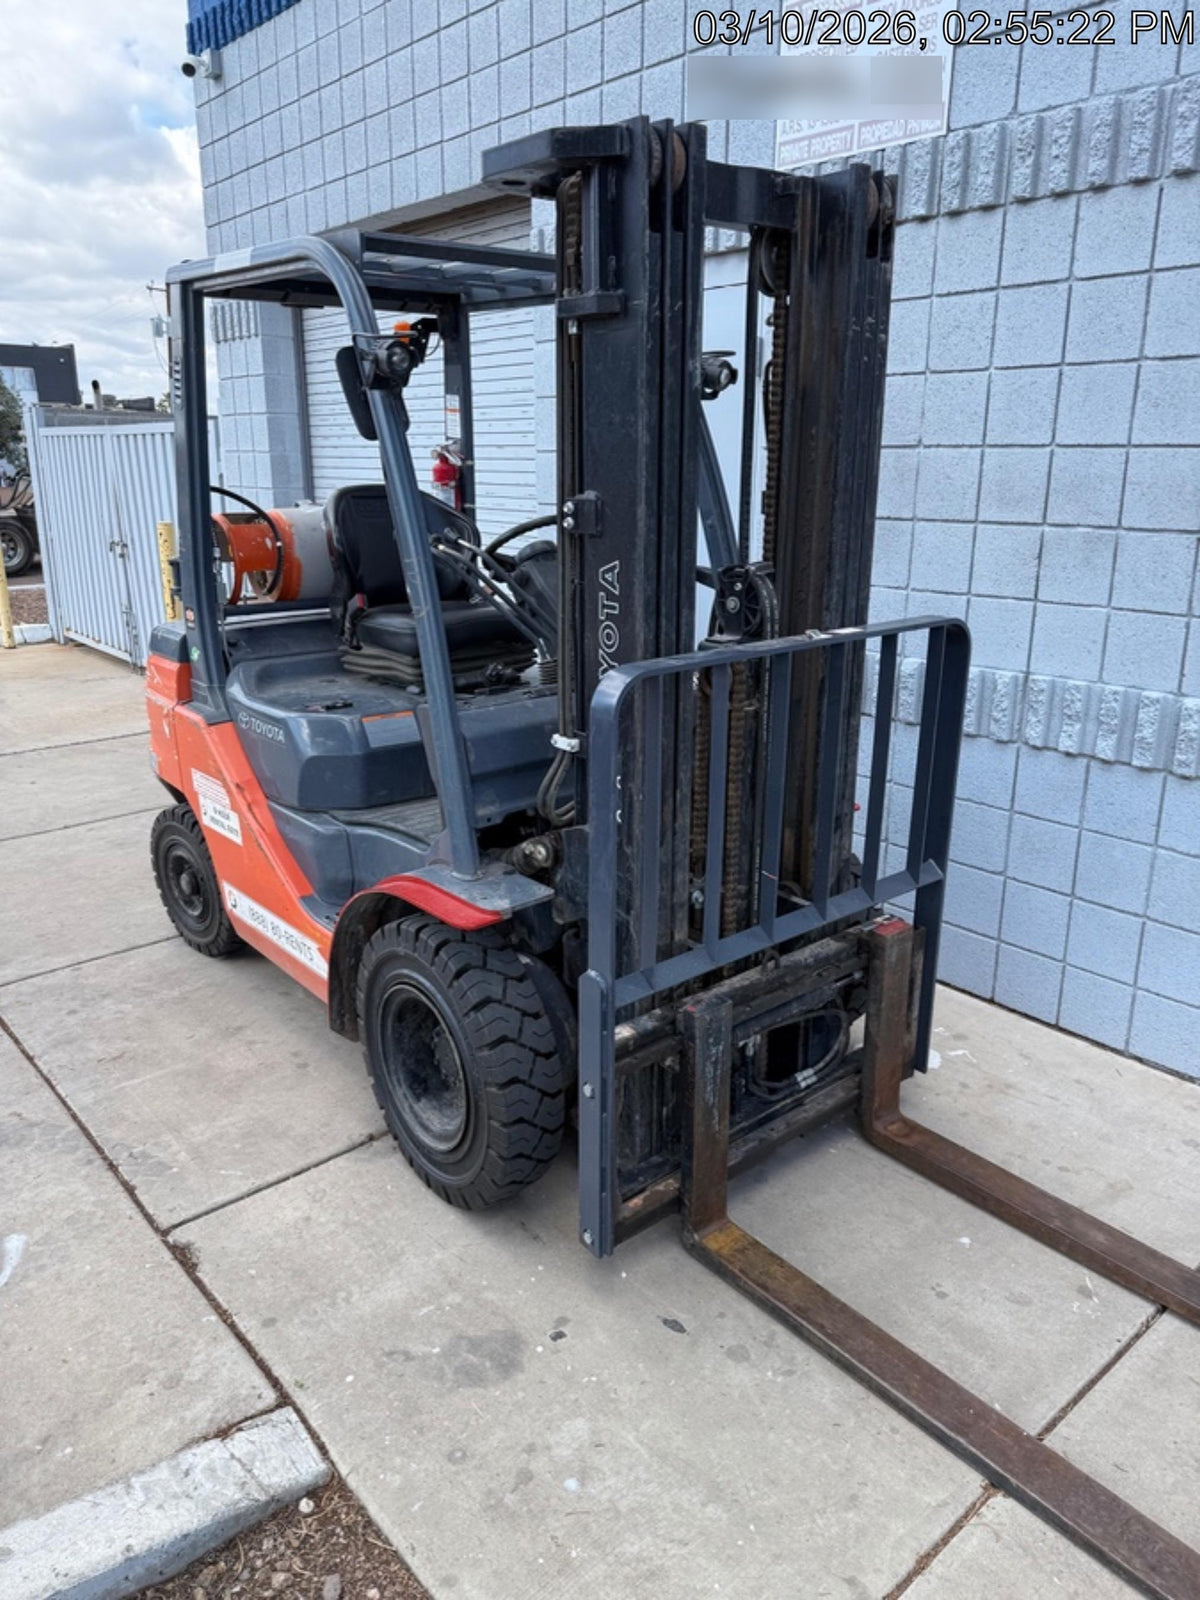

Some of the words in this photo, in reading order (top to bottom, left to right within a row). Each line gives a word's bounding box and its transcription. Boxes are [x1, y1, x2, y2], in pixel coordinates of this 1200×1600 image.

[810, 131, 852, 159] PROPERTY
[598, 560, 619, 680] YOTA
[251, 717, 285, 744] TOYOTA
